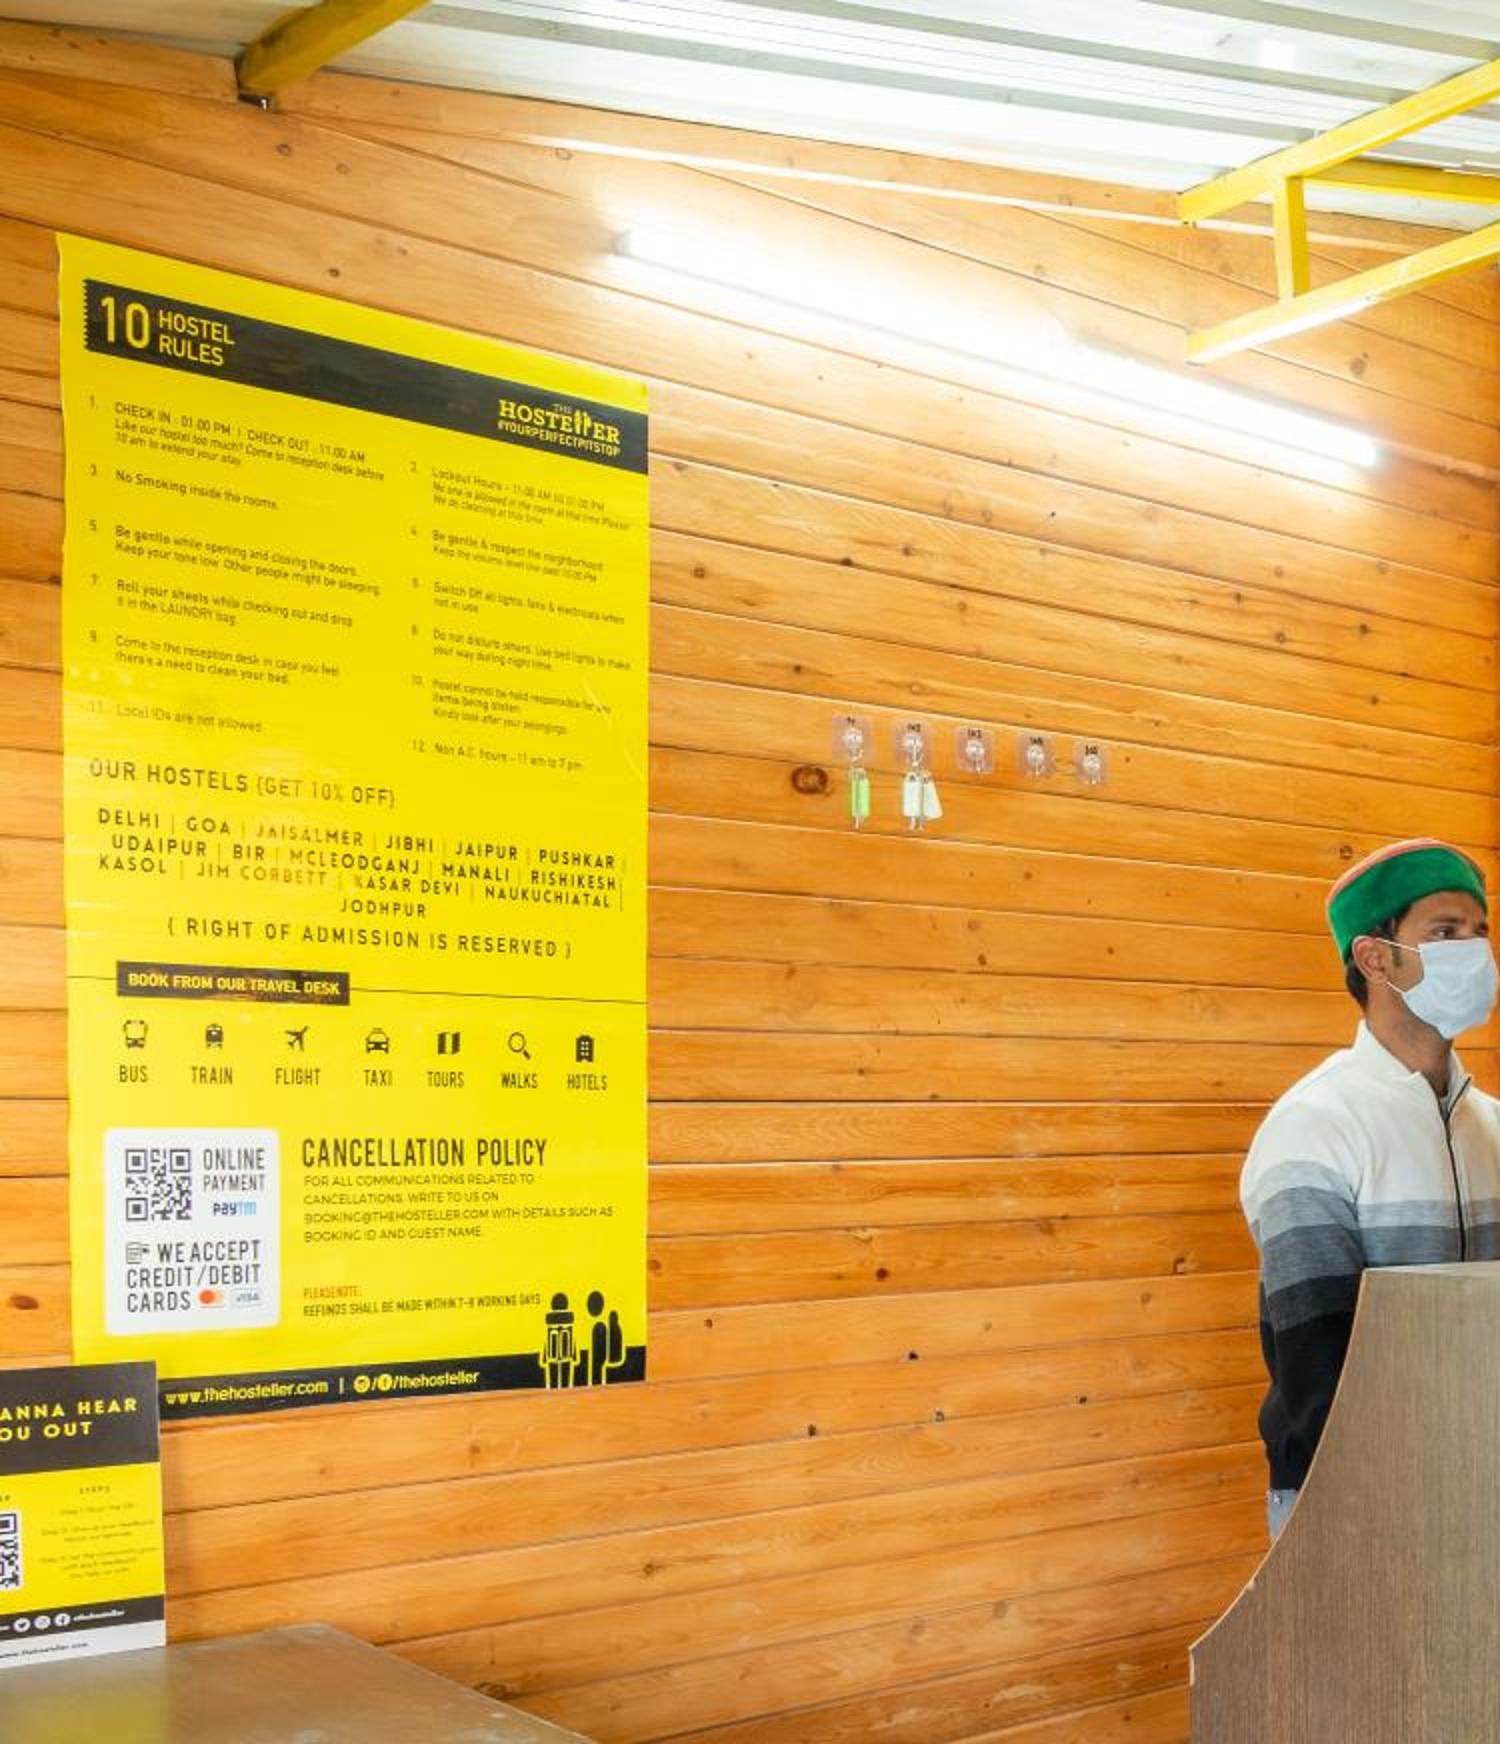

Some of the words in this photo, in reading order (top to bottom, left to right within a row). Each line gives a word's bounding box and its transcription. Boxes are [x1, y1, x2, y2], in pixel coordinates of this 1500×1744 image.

[101, 296, 150, 349] 10
[159, 310, 235, 346] HOSTEL
[159, 335, 224, 367] RULES
[114, 401, 155, 420] CHECK
[213, 420, 231, 436] PM
[247, 429, 285, 447] CHECK
[287, 437, 309, 452] OUT
[348, 449, 366, 463] AM
[116, 470, 132, 484] No
[135, 472, 187, 496] Smoking
[190, 484, 221, 500] inside
[224, 489, 240, 503] the
[115, 525, 131, 539] Be
[135, 528, 171, 547] gentle
[174, 535, 202, 550] while
[205, 541, 247, 561] opening
[250, 549, 269, 562] and
[310, 558, 326, 572] the
[117, 579, 139, 593] Roll
[142, 585, 168, 601] your
[140, 599, 158, 612] the
[160, 603, 213, 621] LAUNDRY
[115, 635, 147, 650] Come
[164, 642, 181, 655] the
[184, 645, 233, 664] reception
[117, 703, 149, 719] Local
[90, 758, 136, 782] OUR
[147, 763, 248, 792] HOSTELS
[312, 781, 343, 801] 10%
[98, 808, 159, 829] DELHI
[186, 816, 231, 835] GOA
[256, 823, 363, 846] JAISALMER
[386, 836, 433, 852] JIBHI
[455, 842, 518, 860] JAIPUR
[539, 849, 615, 869] PUSHKAR
[112, 835, 207, 857] UDAIPUR
[233, 844, 265, 861] BIR
[290, 850, 420, 875] MCLEODGANJ
[442, 863, 510, 882] MANALI
[531, 871, 616, 891] RISHIKESH
[99, 855, 167, 874] KASOL
[196, 864, 230, 878] JIM
[240, 866, 327, 885] CORBETT
[355, 875, 410, 892] KASAR
[421, 879, 459, 896] DEVI
[486, 885, 609, 909] NAUKUCHIATAL
[339, 899, 426, 918] JODHPUR
[187, 917, 253, 938] RIGHT
[265, 924, 290, 940] OF
[303, 927, 419, 948] ADMISSION
[431, 933, 447, 950] IS
[458, 935, 557, 957] RESERVED
[128, 973, 169, 988] BOOK
[173, 975, 213, 990] FROM
[217, 977, 246, 991] OUR
[250, 979, 300, 994] TRAVEL
[303, 981, 340, 996] DESK
[119, 1065, 148, 1083] BUS
[192, 1066, 233, 1085] TRAIN
[275, 1067, 321, 1086] FLIGHT
[364, 1069, 393, 1087] TAXI
[427, 1070, 464, 1089] TOURS
[501, 1072, 538, 1090] WALKS
[568, 1073, 607, 1092] HOTELS
[203, 1148, 266, 1172] ONLINE
[302, 1137, 465, 1168] CANCELLATION
[477, 1137, 547, 1167] POLICY
[203, 1174, 266, 1193] PAYMENT
[304, 1175, 329, 1187] FOR
[332, 1175, 353, 1187] ALL
[355, 1174, 465, 1187] COMMUNICATIONS
[467, 1173, 517, 1185] RELATED
[519, 1173, 535, 1184] TO
[407, 1191, 445, 1203] WRITE
[447, 1191, 462, 1202] TO
[463, 1191, 479, 1201] US
[482, 1191, 499, 1201] ON
[304, 1208, 489, 1224] BOOKING@THEHOSTELLER.COM
[492, 1208, 520, 1219] WITH
[523, 1207, 567, 1219] DETAILS
[567, 1207, 597, 1217] SUCH
[600, 1206, 613, 1217] AS
[304, 1230, 361, 1243] BOOKING
[364, 1229, 377, 1241] ID
[379, 1229, 405, 1240] AND
[408, 1228, 446, 1239] GUEST
[157, 1242, 185, 1263] WE
[190, 1239, 260, 1262] ACCEPT
[127, 1290, 191, 1313] CARDS
[303, 1303, 347, 1317] REFUNDS
[349, 1301, 379, 1314] SHALL
[382, 1300, 394, 1312] BE
[396, 1299, 423, 1312] MADE
[425, 1297, 457, 1311] WITHIN
[478, 1294, 517, 1307] WORKING
[520, 1292, 541, 1305] DAYS
[165, 1380, 328, 1404] www.thehosteller.com
[77, 1397, 137, 1415] HEAR
[43, 1420, 92, 1438] OUT
